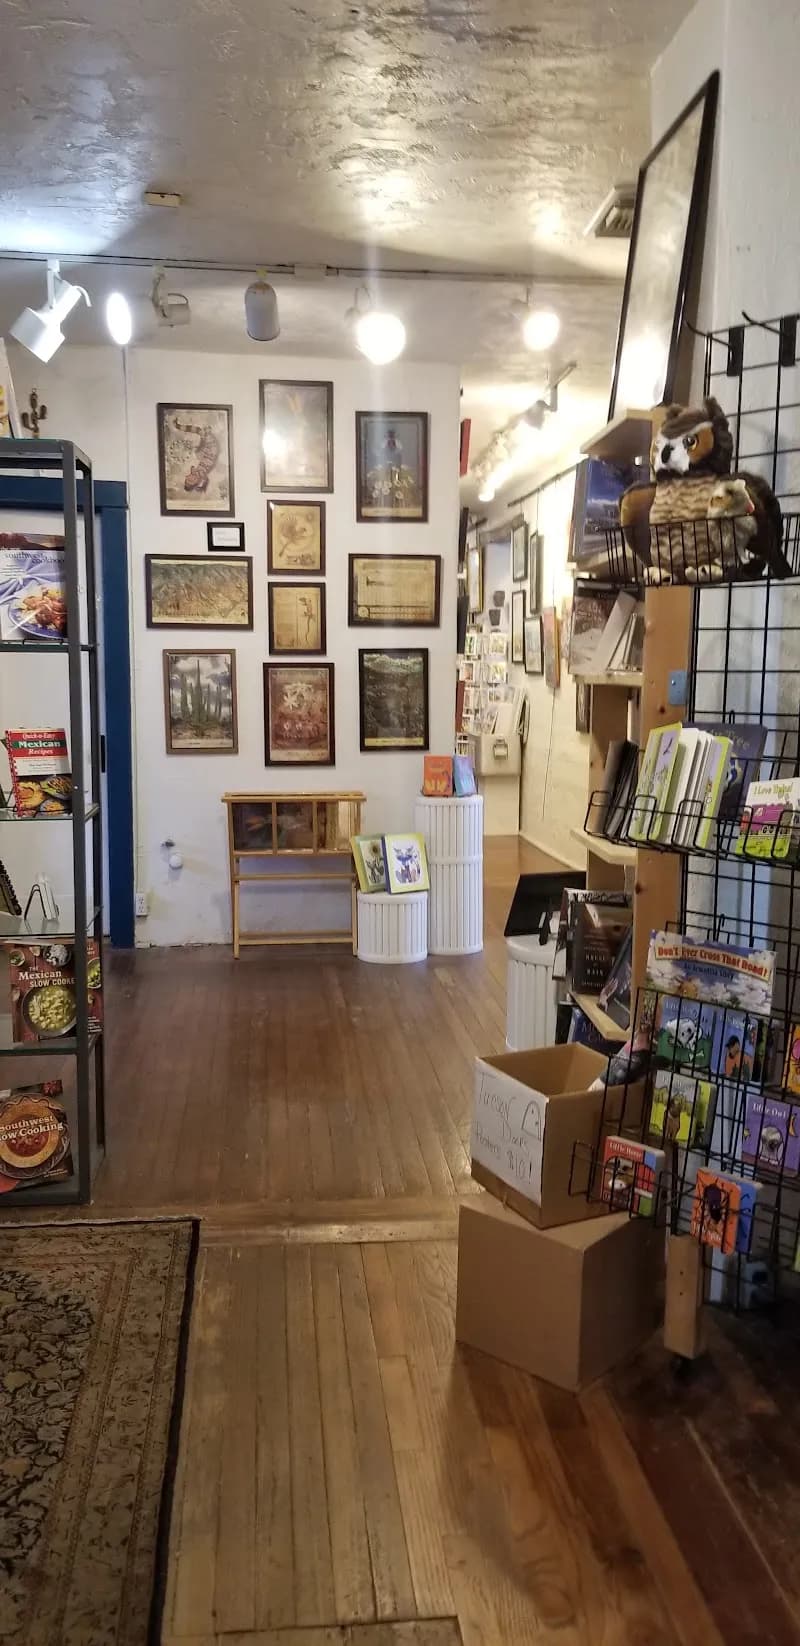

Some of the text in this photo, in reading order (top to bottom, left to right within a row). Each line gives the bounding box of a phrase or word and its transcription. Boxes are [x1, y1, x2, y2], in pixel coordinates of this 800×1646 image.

[31, 556, 64, 564] cookboo
[658, 946, 679, 956] Don't
[700, 950, 721, 961] Cross
[722, 954, 741, 968] That
[741, 959, 768, 977] Road!
[18, 970, 62, 980] Mexican
[29, 977, 76, 988] SLOW COOKE
[771, 1107, 786, 1119] Owl
[19, 1121, 64, 1137] Cooking
